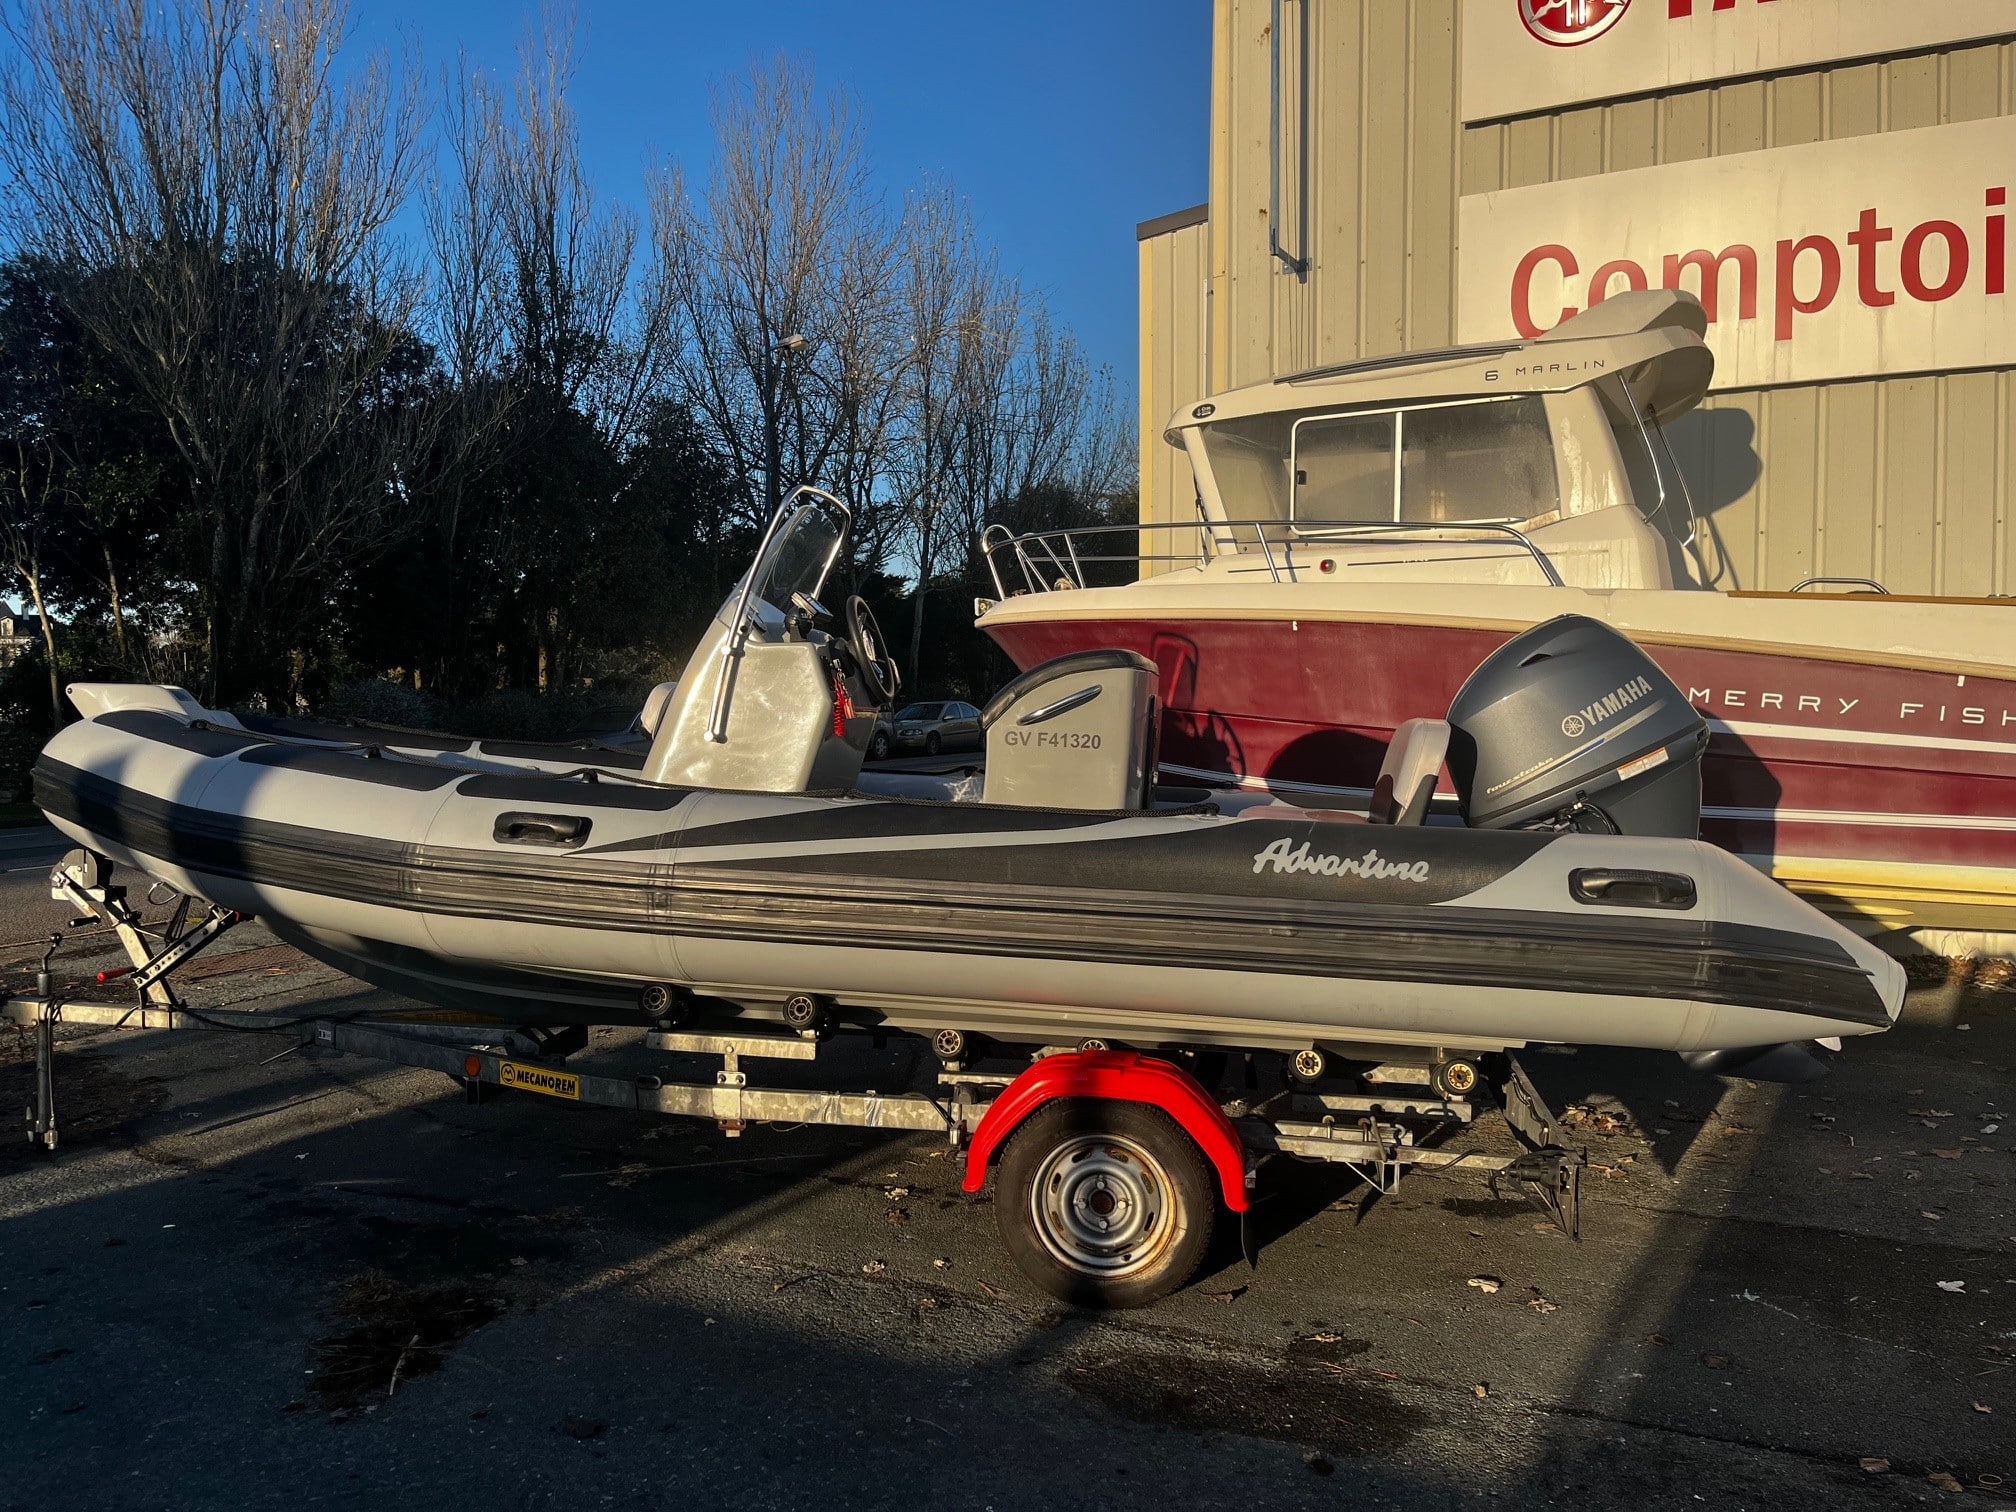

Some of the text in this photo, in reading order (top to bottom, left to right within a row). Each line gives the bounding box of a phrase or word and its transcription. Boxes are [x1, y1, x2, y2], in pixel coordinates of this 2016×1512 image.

[1485, 360, 1605, 381] 6 MARLIN
[1579, 675, 1653, 726] YAMAHA
[1689, 687, 1859, 714] MERRY
[1004, 731, 1101, 750] GV F41320
[516, 1069, 576, 1093] MECANOREM
